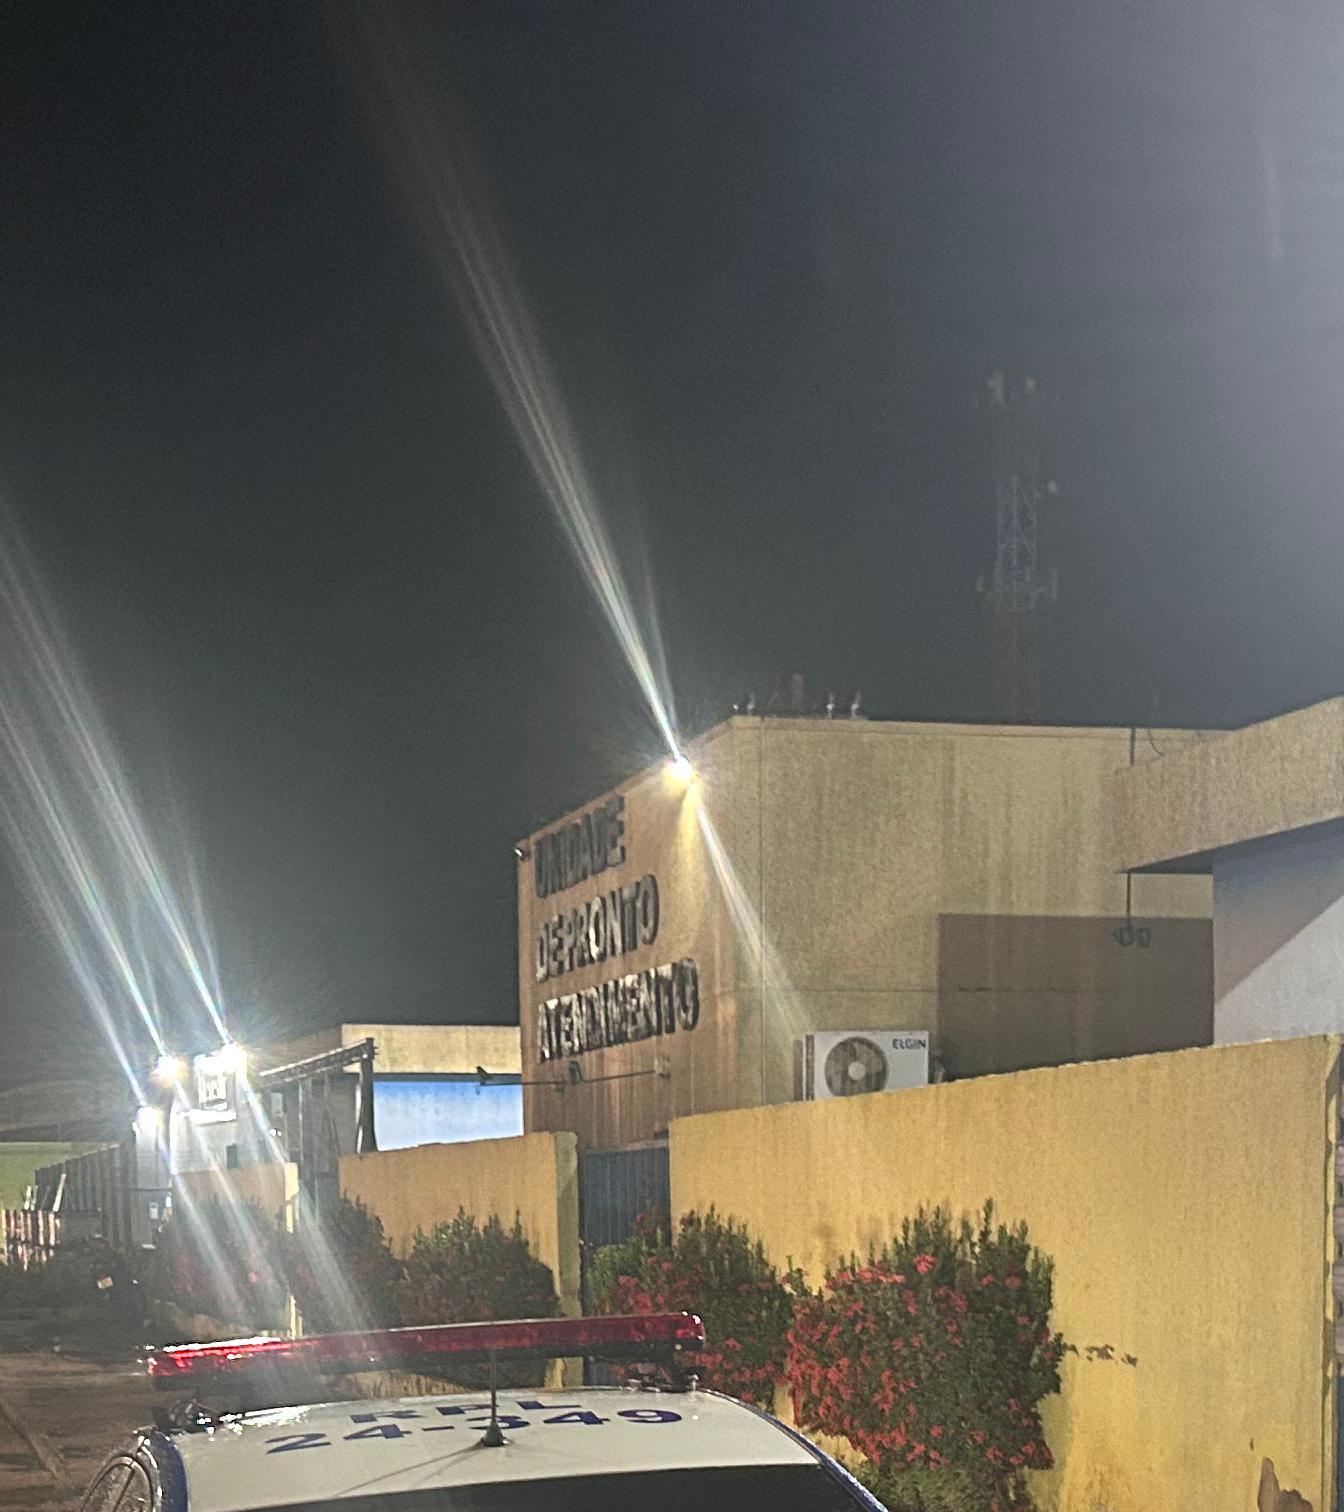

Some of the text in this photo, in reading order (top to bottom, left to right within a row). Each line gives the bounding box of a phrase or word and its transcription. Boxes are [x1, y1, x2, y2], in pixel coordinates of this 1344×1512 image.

[535, 795, 626, 898] UNIDADE
[536, 874, 659, 983] DE PRONTO
[538, 957, 700, 1064] ATENDIMENTO
[350, 1400, 581, 1424] RPL
